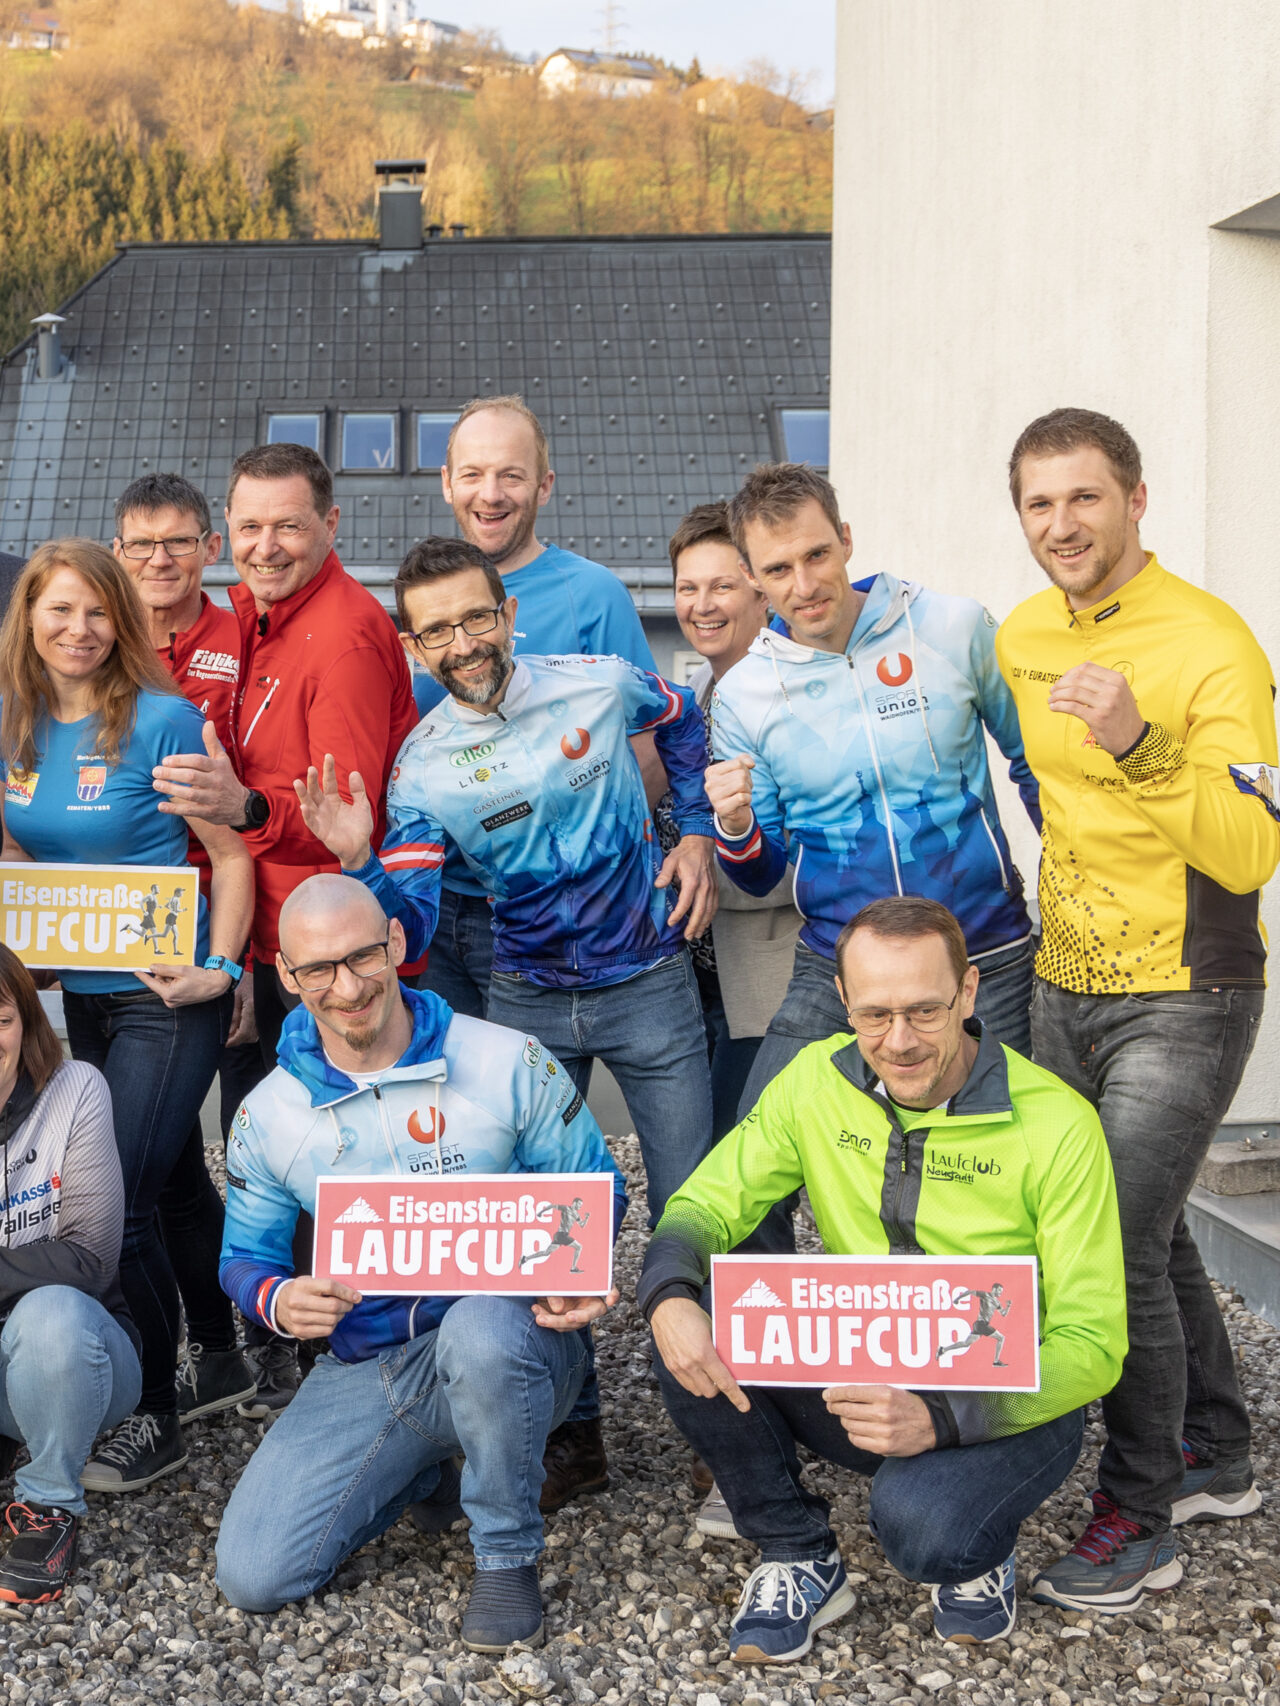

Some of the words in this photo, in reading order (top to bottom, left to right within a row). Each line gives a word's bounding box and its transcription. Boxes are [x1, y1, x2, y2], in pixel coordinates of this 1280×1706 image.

[455, 743, 493, 767] efko
[473, 788, 524, 815] GASTEINER
[484, 804, 530, 827] GLANZWERK
[3, 880, 144, 909] Eisenstraße
[388, 1194, 553, 1223] Eisenstraße
[329, 1229, 553, 1276] LAUFCUP
[791, 1277, 972, 1311] Eisenstraße
[730, 1314, 972, 1368] LAUFCUP
